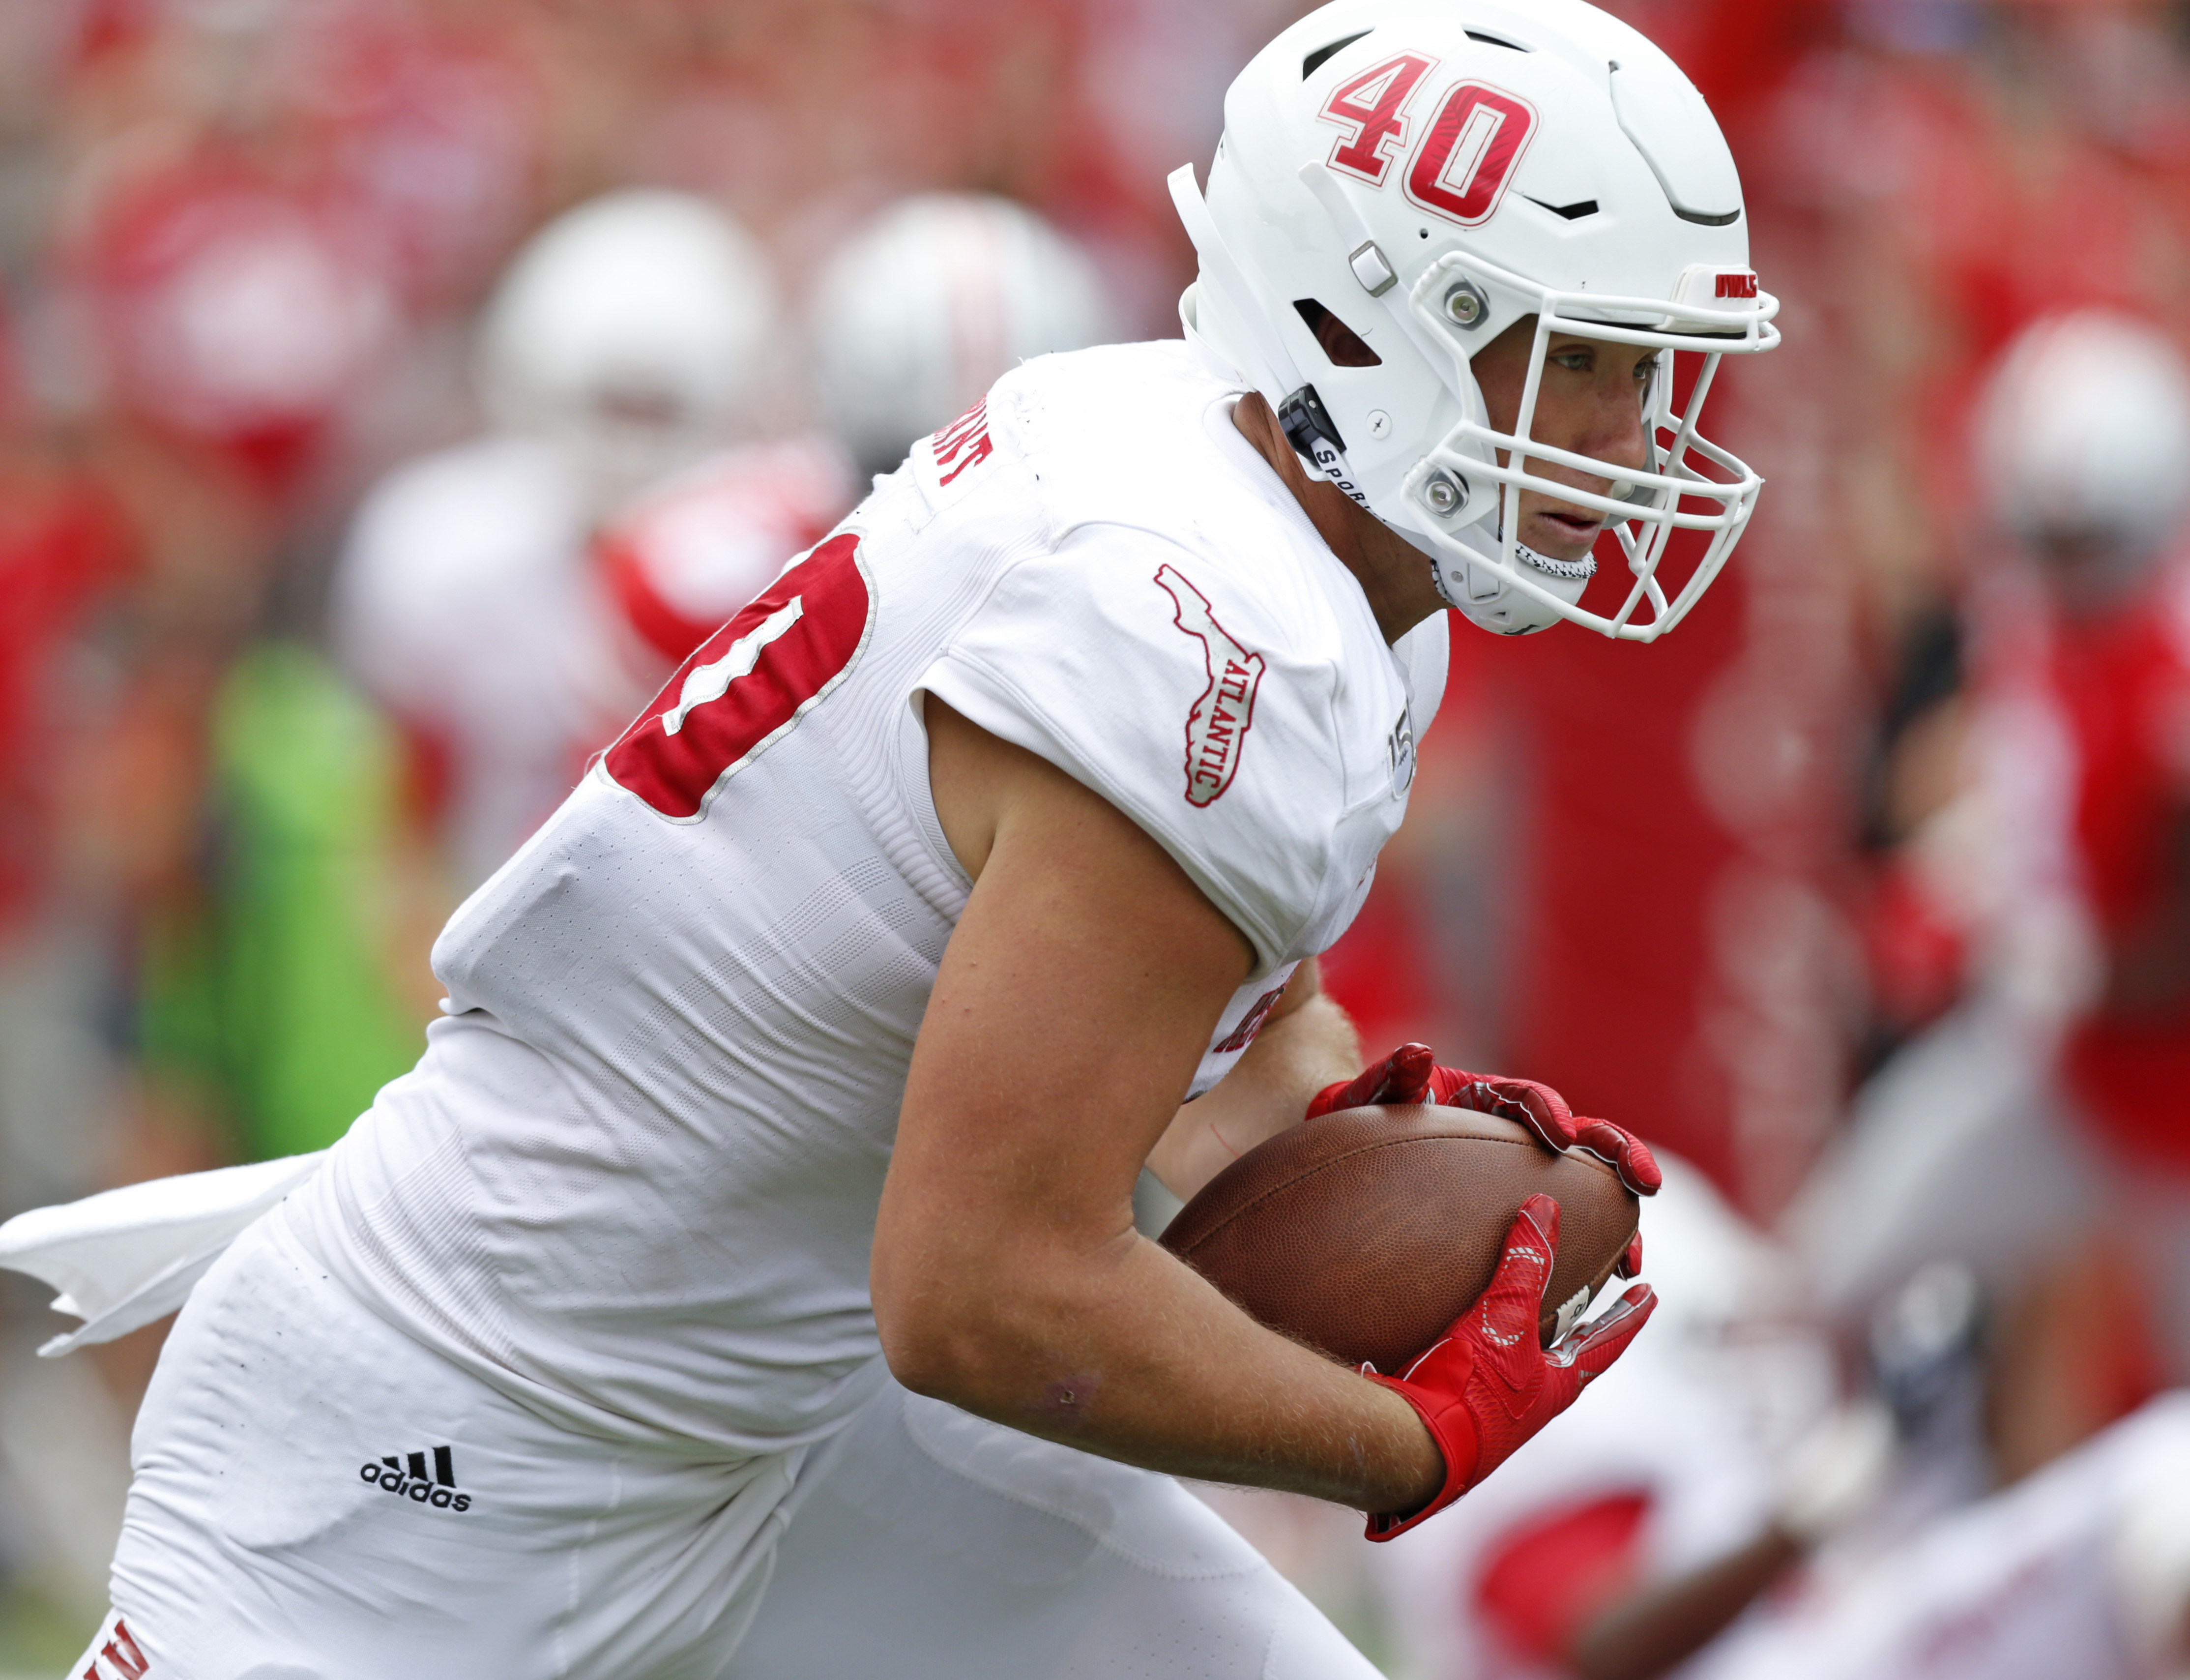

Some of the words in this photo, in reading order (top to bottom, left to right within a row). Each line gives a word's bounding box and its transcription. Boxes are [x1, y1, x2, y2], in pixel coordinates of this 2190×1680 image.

[1318, 48, 1540, 227] 40
[1715, 274, 1757, 298] OWLS
[1195, 659, 1251, 788] ATLANTIC
[360, 1463, 471, 1512] adidas
